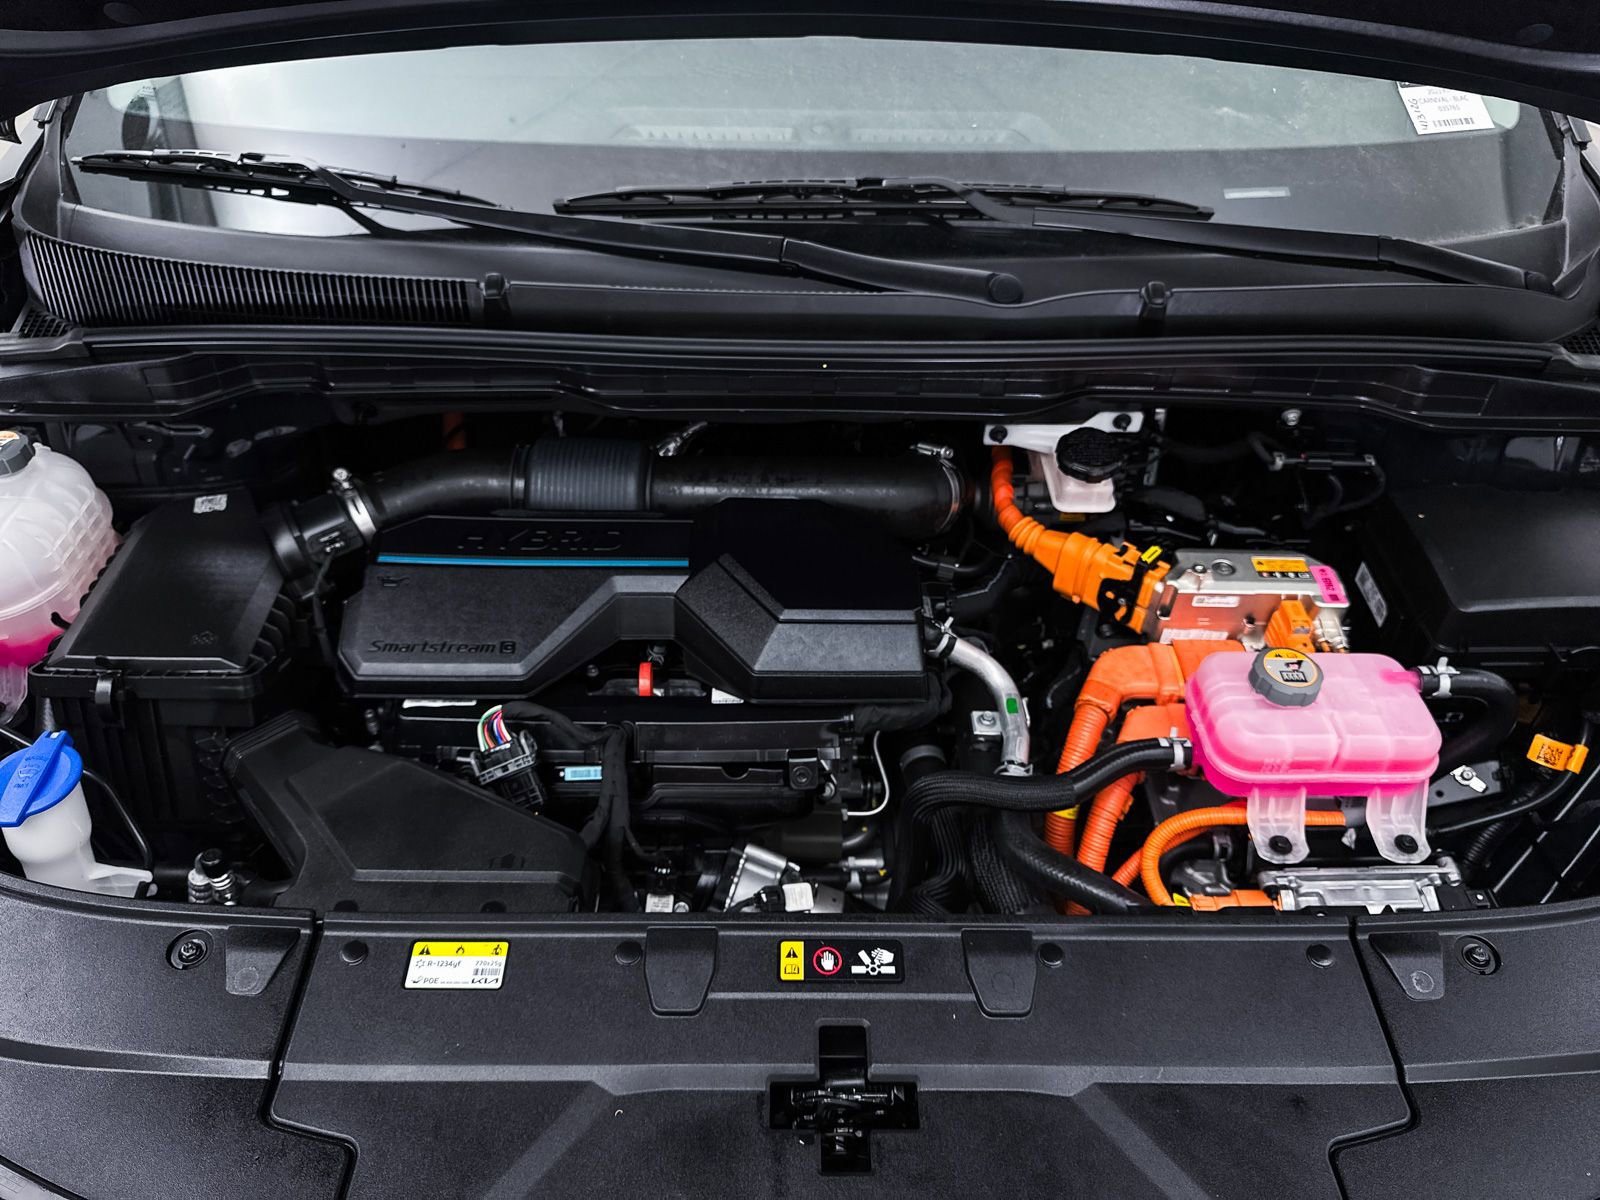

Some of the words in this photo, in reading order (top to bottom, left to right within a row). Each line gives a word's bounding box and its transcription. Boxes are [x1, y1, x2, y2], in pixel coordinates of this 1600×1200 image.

[368, 640, 496, 654] Smartstream
[427, 960, 463, 969] R-1234yf
[471, 977, 499, 985] KIA
